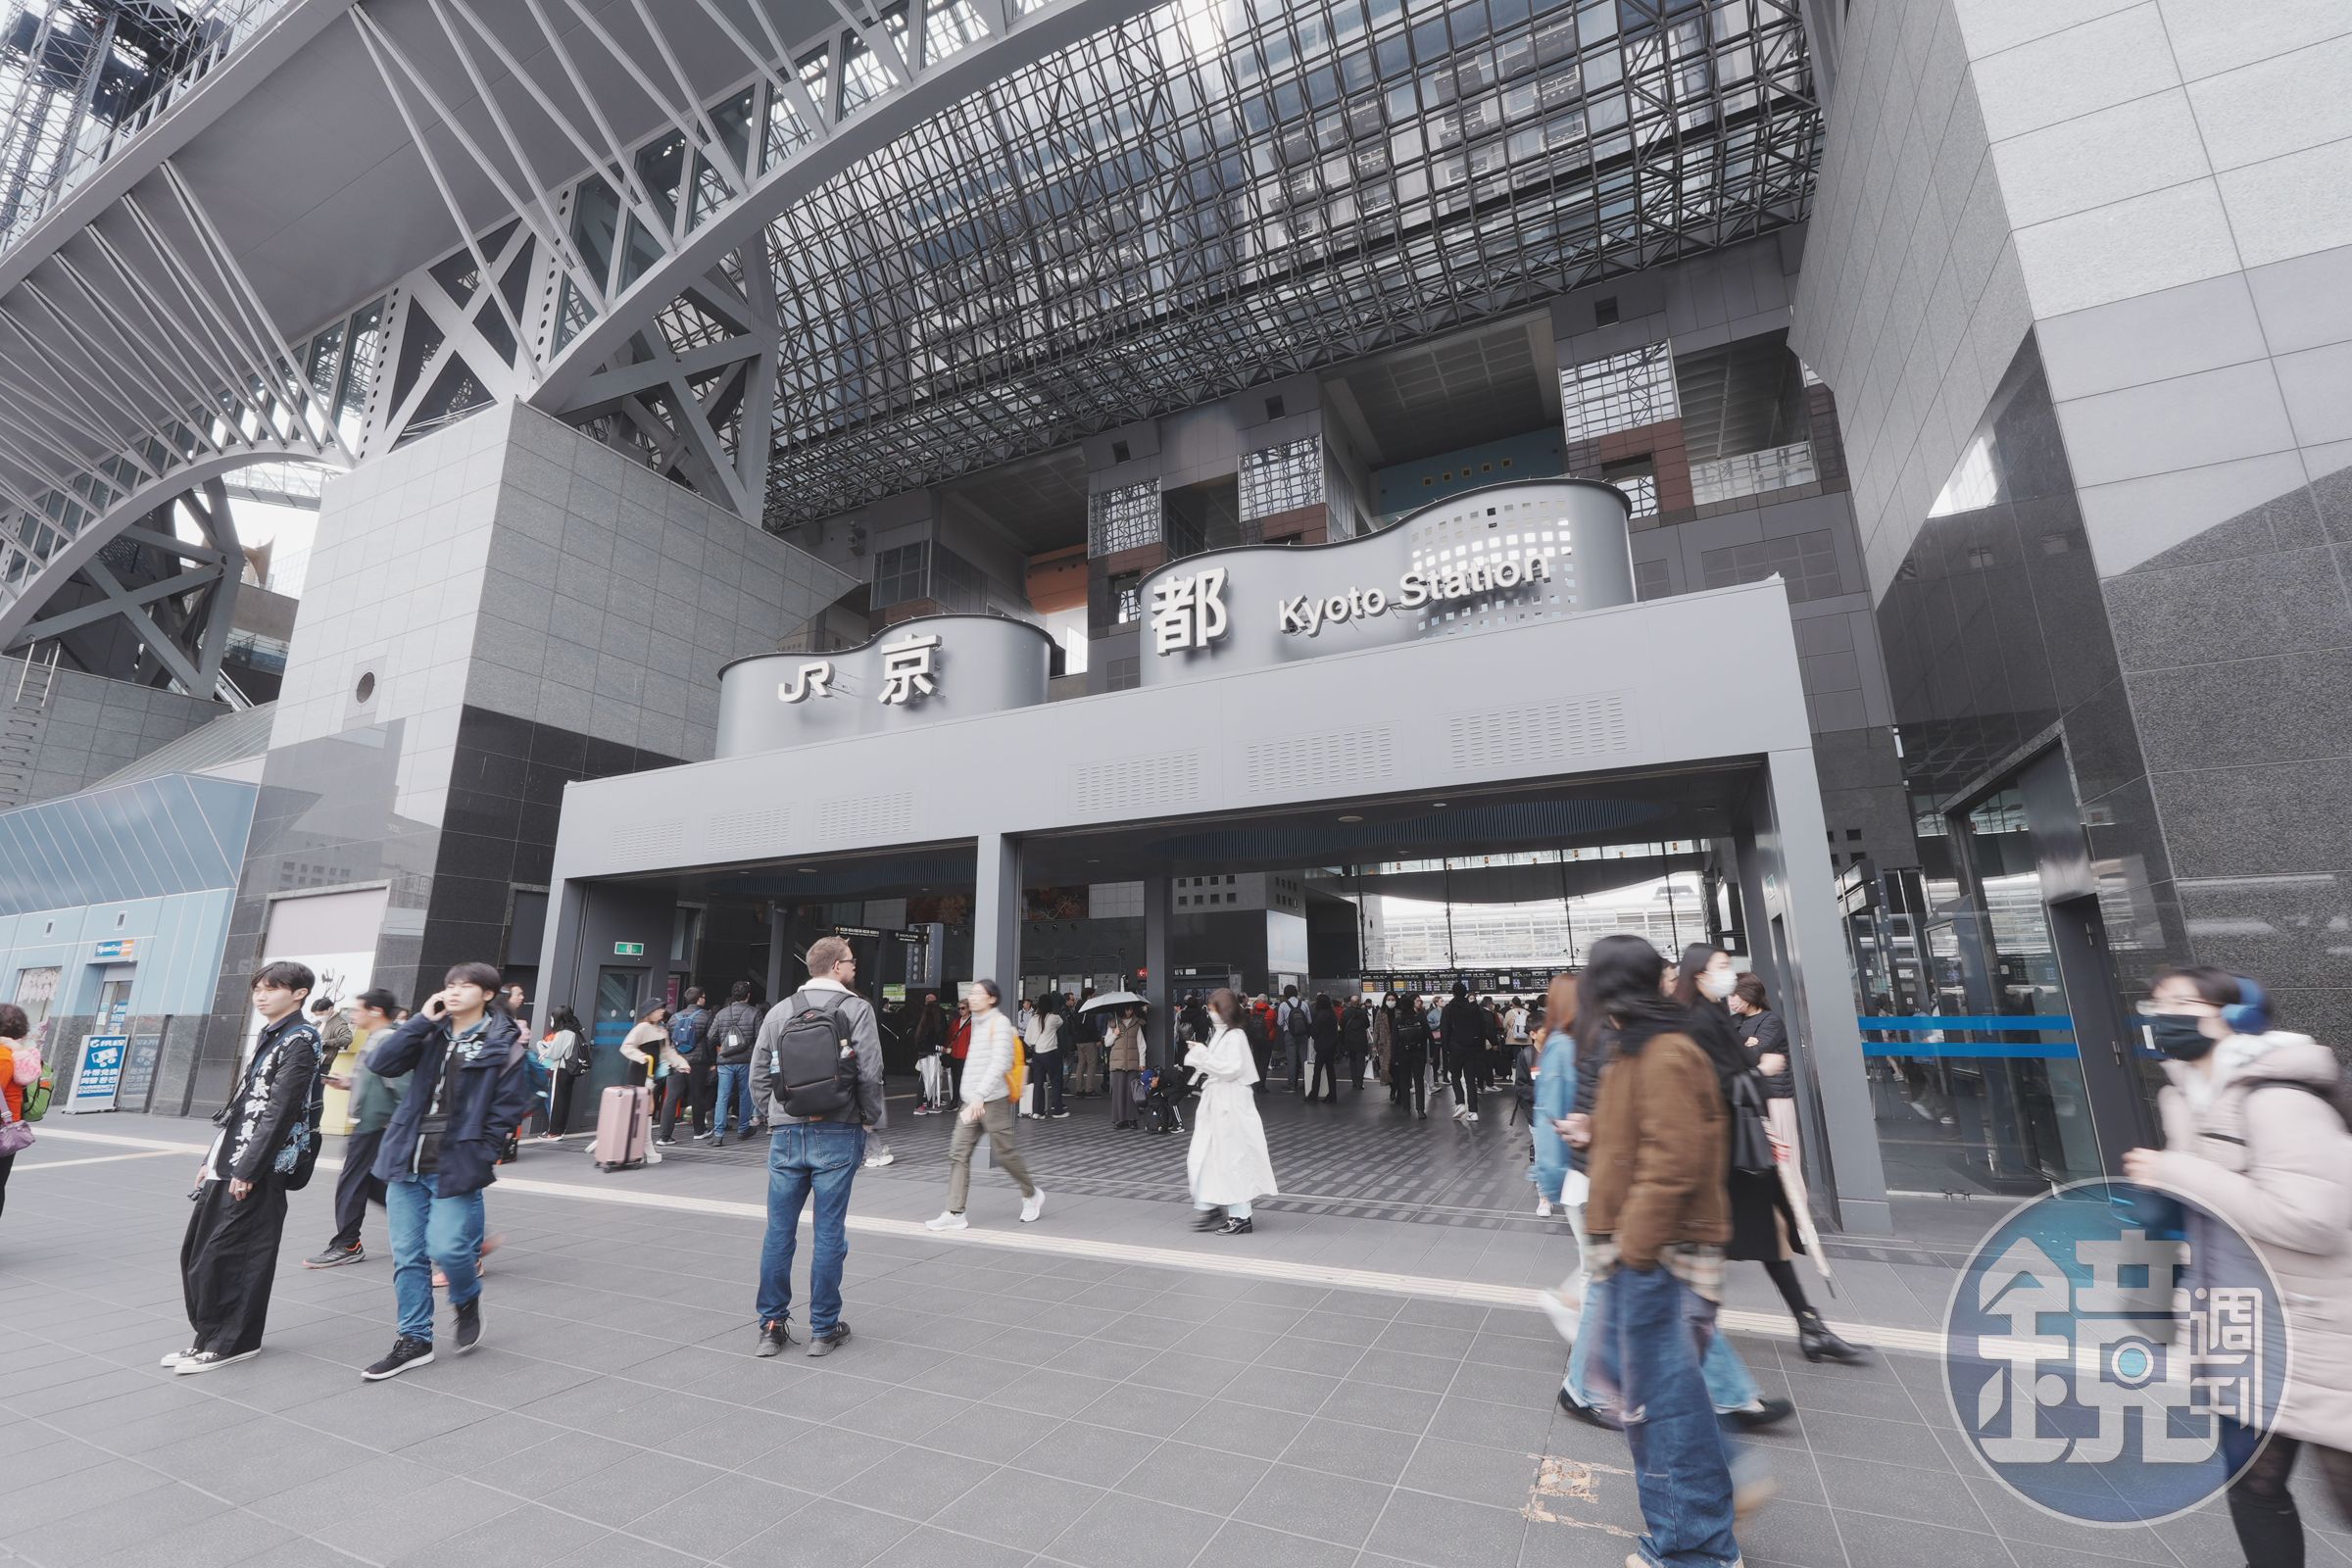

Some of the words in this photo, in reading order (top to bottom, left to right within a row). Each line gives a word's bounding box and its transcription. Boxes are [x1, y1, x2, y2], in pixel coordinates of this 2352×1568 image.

[877, 633, 943, 707] 京
[1151, 566, 1229, 657] 都
[1279, 586, 1388, 637] Kyoto
[1398, 553, 1551, 609] Station
[778, 660, 835, 704] JR
